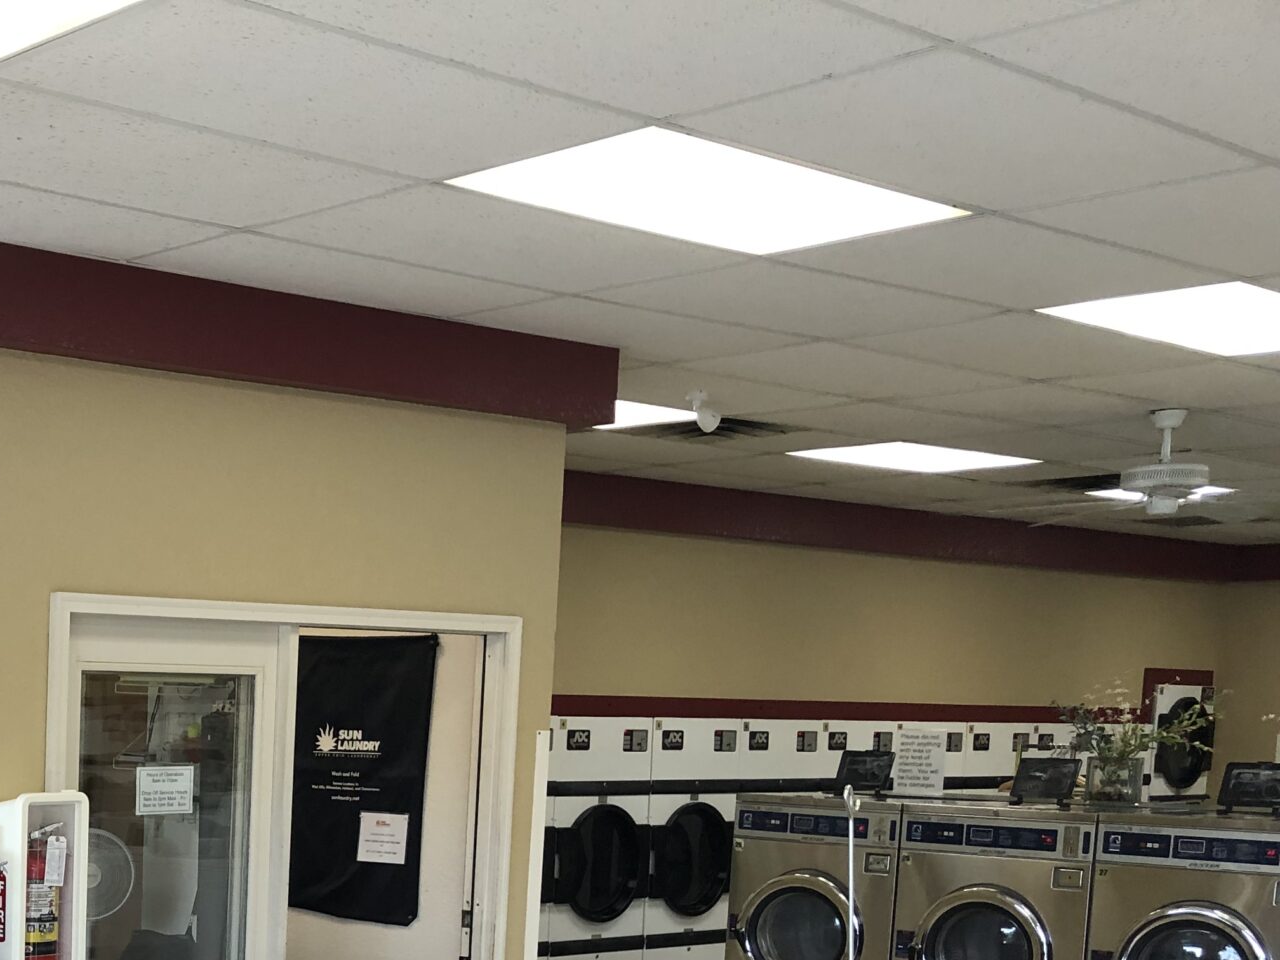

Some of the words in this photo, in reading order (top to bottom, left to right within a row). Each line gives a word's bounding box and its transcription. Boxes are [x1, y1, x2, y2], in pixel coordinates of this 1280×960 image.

[338, 729, 363, 740] SUN
[337, 740, 381, 752] LAUNDRY
[1099, 868, 1109, 877] 27
